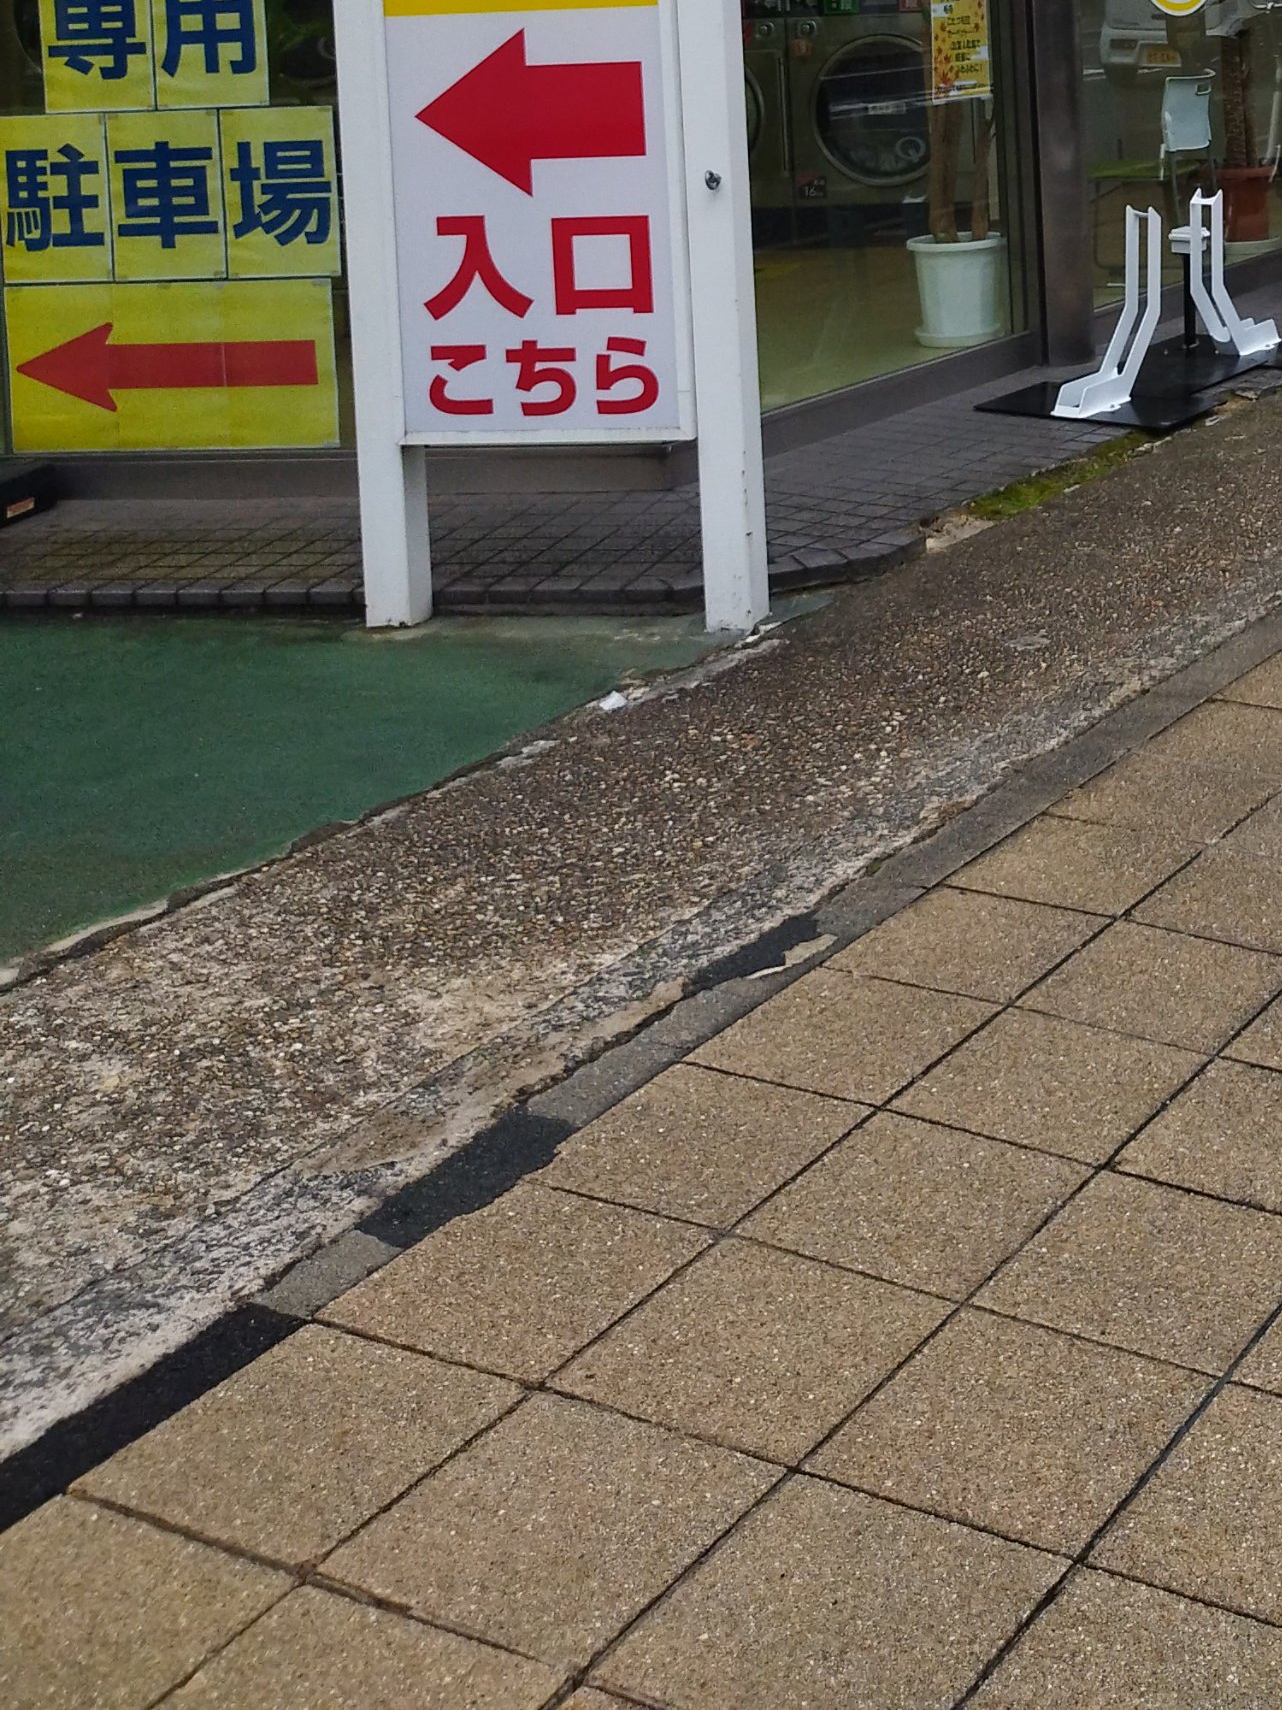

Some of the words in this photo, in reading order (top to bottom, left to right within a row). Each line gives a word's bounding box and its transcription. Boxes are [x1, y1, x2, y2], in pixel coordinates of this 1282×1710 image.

[4, 138, 334, 251] 駐車場
[424, 214, 655, 320] 入口
[428, 336, 660, 417] こちら
